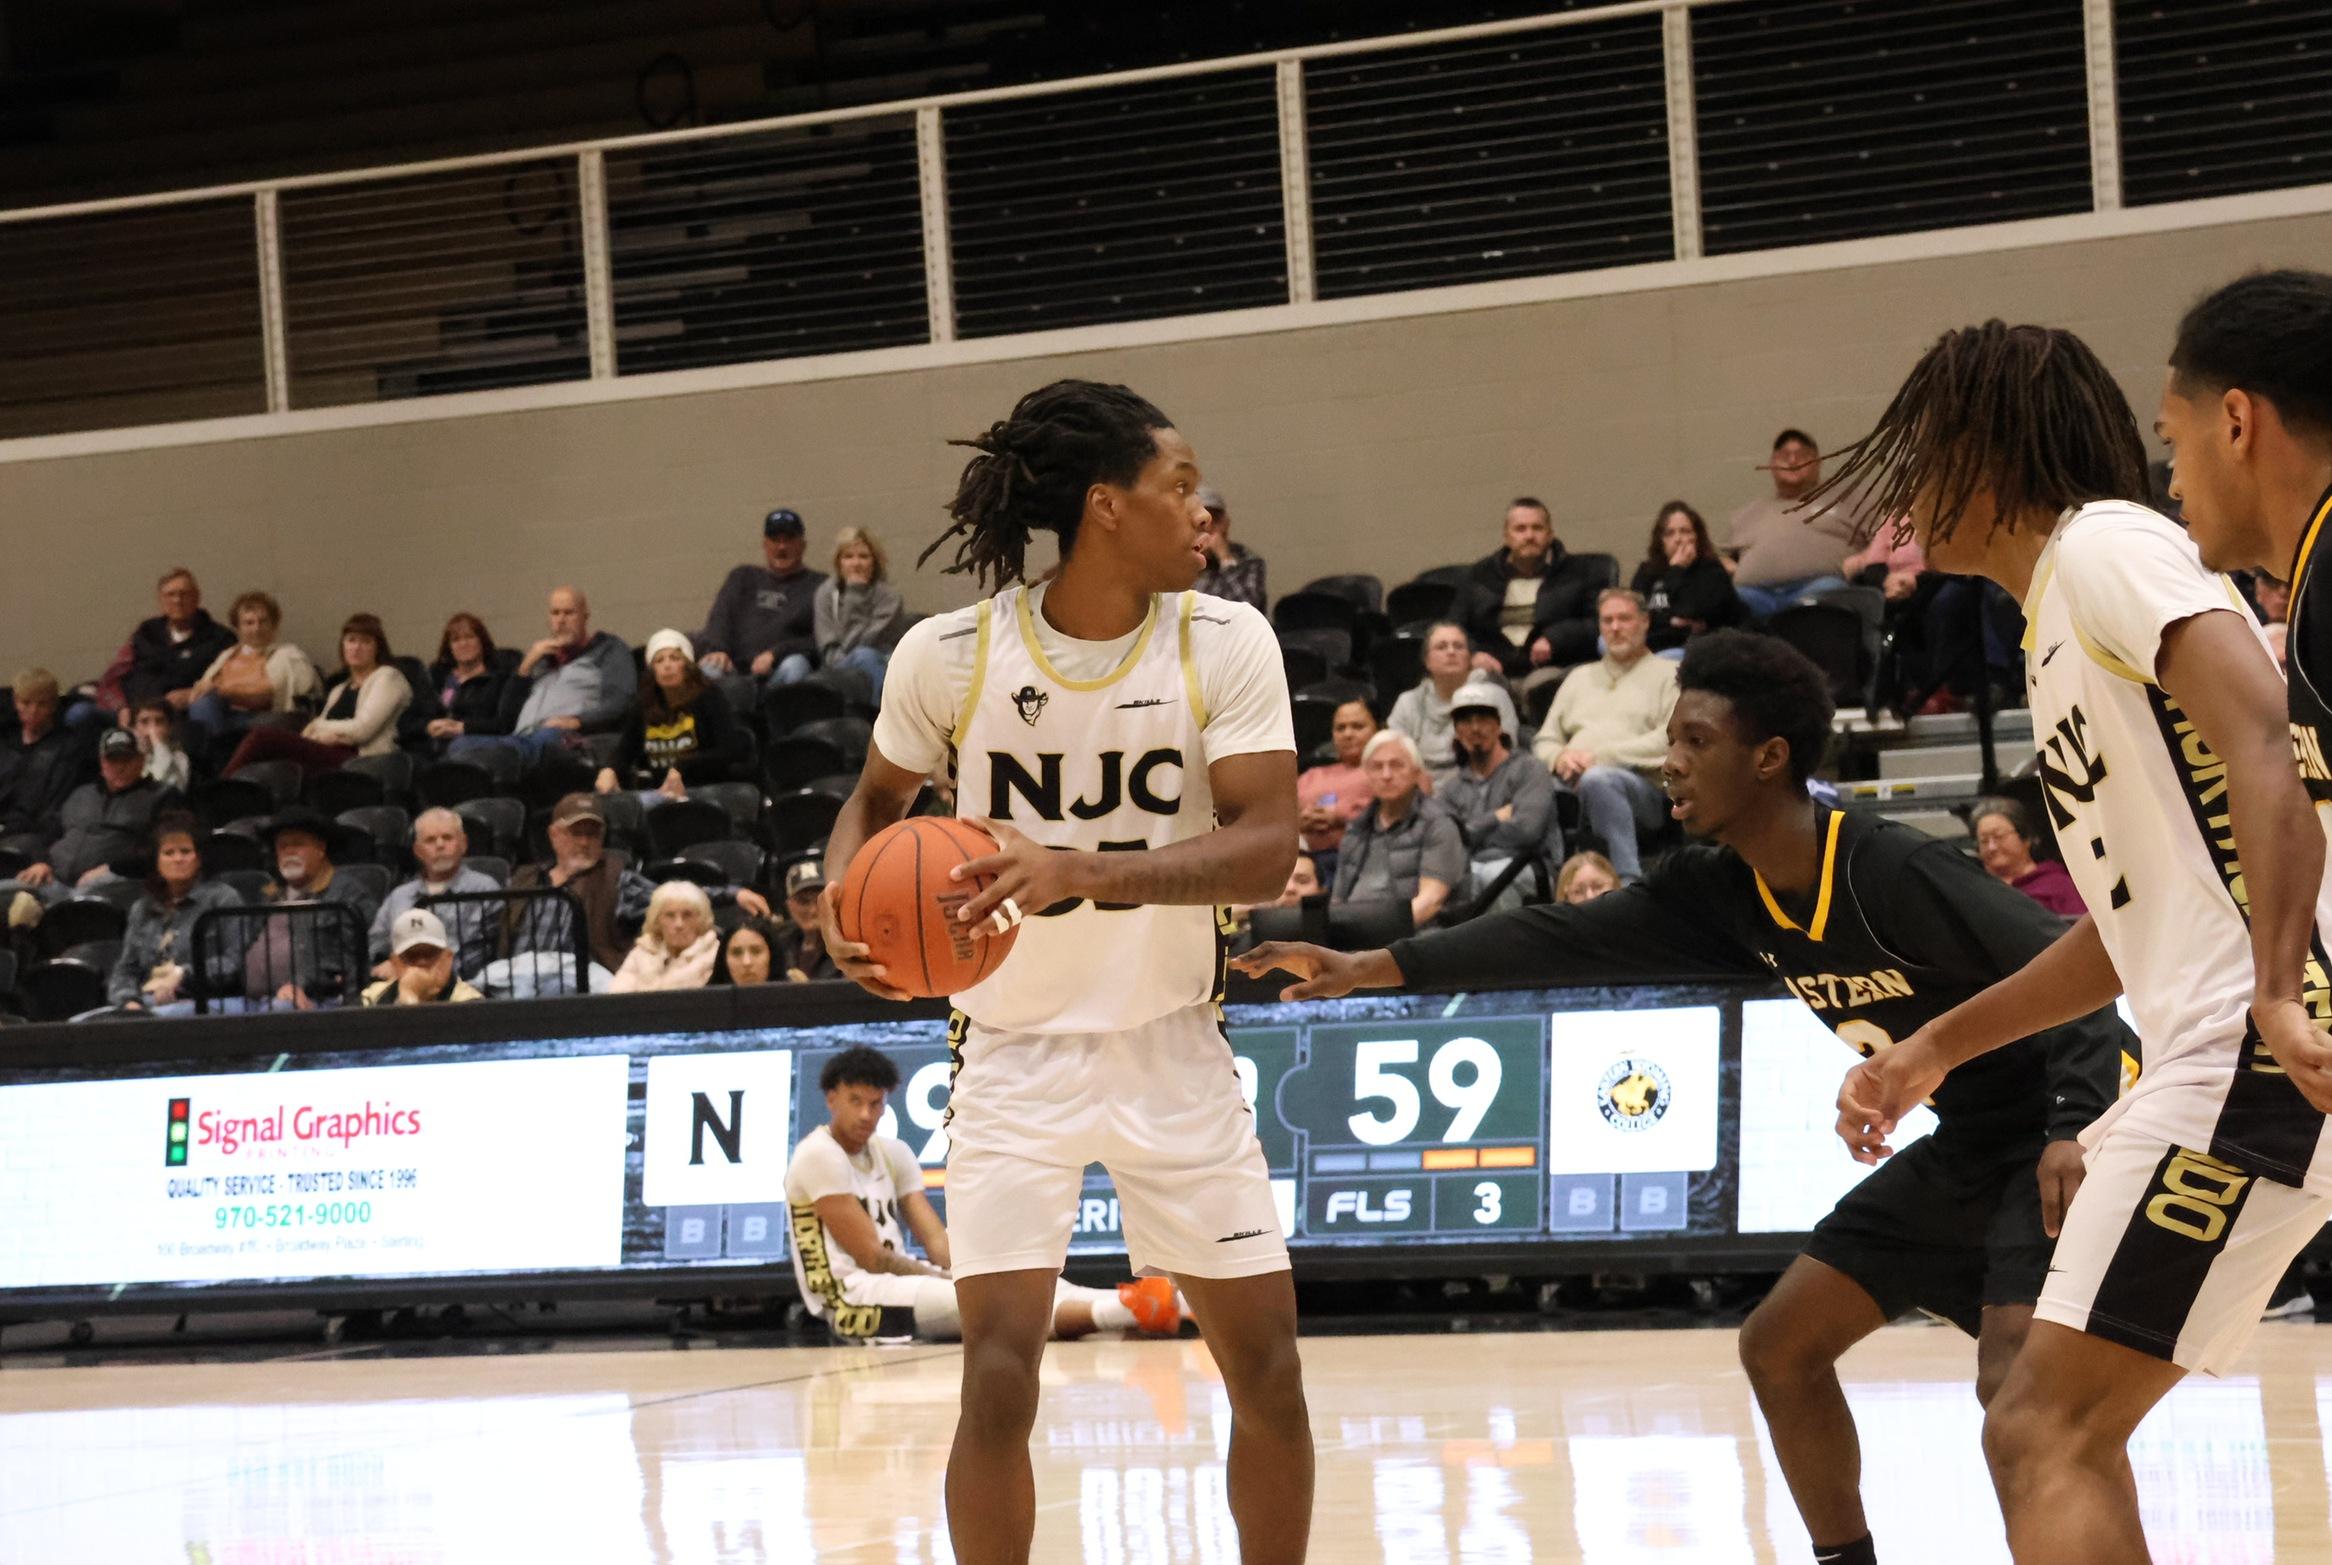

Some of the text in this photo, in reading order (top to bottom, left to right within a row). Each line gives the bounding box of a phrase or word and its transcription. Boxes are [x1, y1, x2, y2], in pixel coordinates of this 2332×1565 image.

[986, 747, 1184, 822] NJC
[1348, 1036, 1502, 1146] 59
[198, 1100, 421, 1155] Signal Graphics
[689, 1089, 745, 1165] N
[167, 1176, 220, 1198] QUALITY
[225, 1173, 276, 1196] SERVICE
[287, 1170, 343, 1193] TRUSTED
[348, 1168, 385, 1190] SINCE
[215, 1200, 372, 1229] 970-521-9000
[1327, 1190, 1412, 1223] FLS
[1473, 1182, 1502, 1225] 3
[1569, 1187, 1597, 1215] B
[1640, 1186, 1668, 1214] B
[681, 1218, 703, 1244] B
[742, 1215, 768, 1242] B
